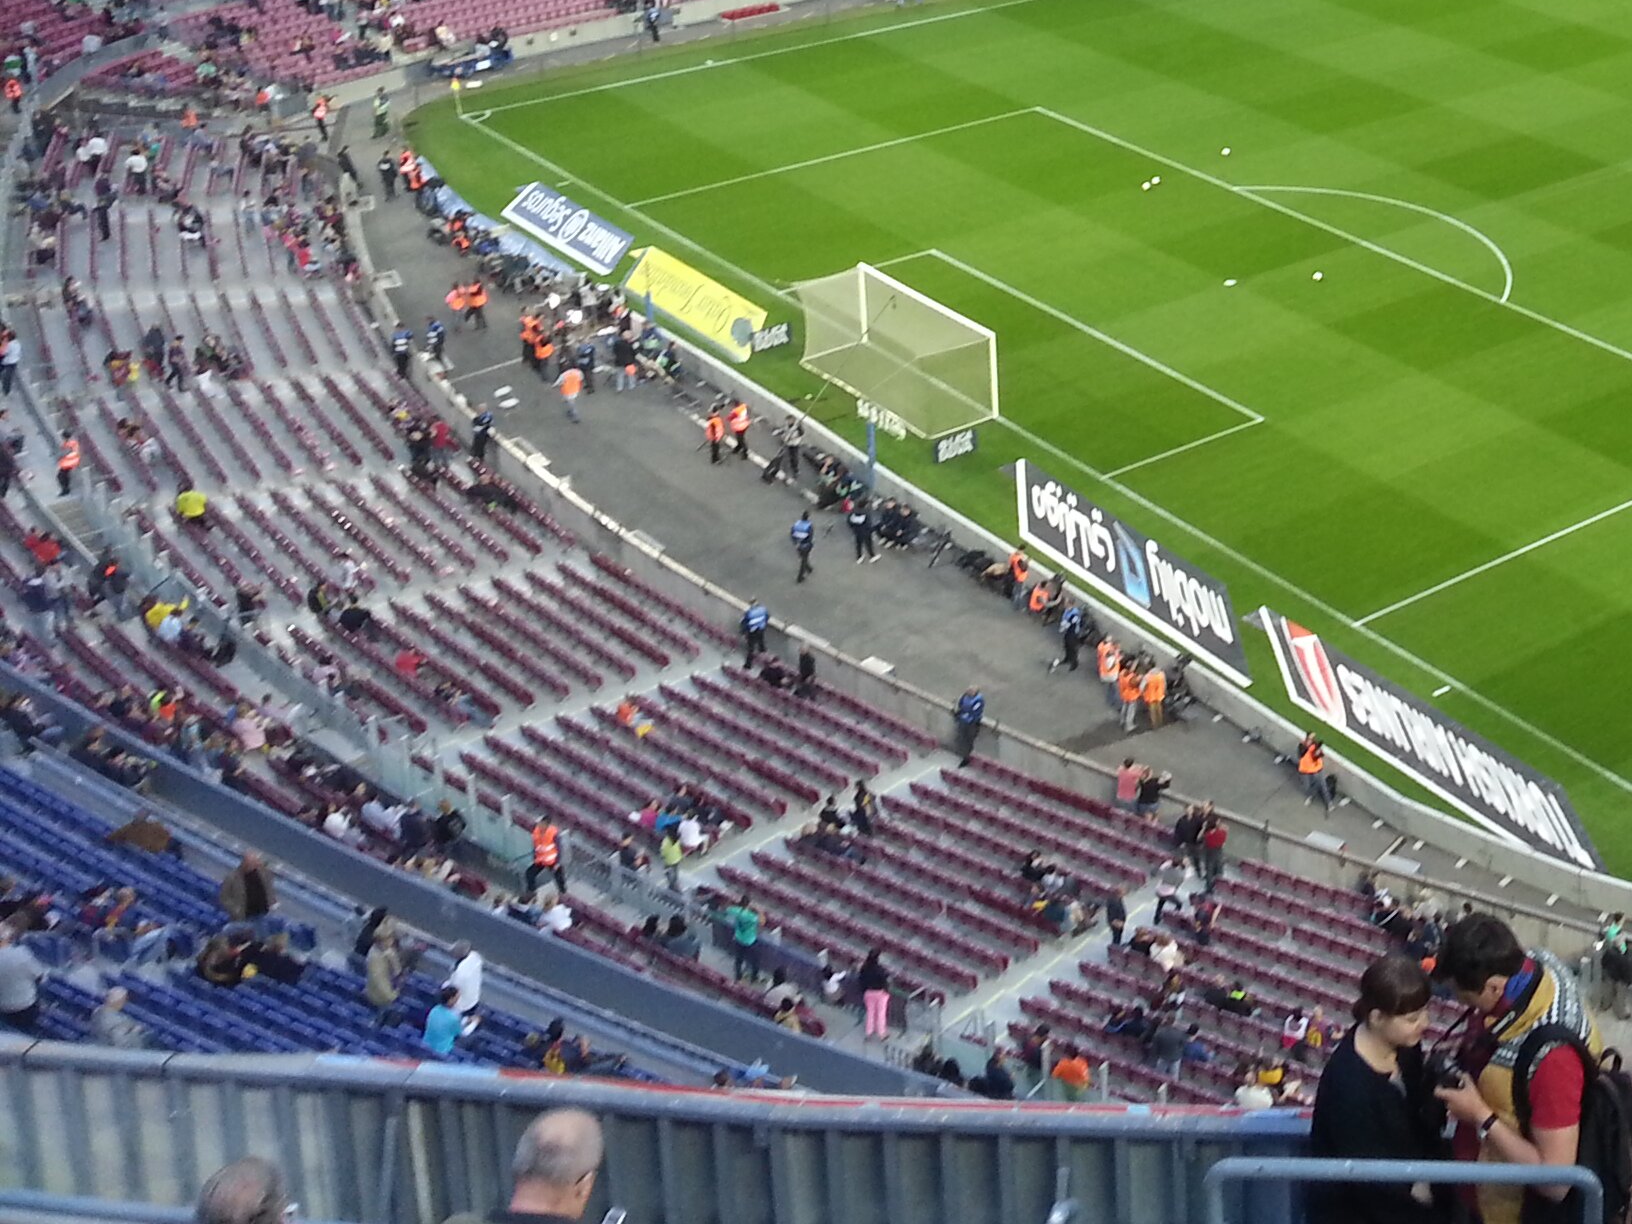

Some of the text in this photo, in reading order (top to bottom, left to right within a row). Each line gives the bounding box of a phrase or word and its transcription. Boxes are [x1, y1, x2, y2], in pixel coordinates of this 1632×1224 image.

[521, 189, 626, 264] Allianz Seguros
[1144, 539, 1234, 644] mobily
